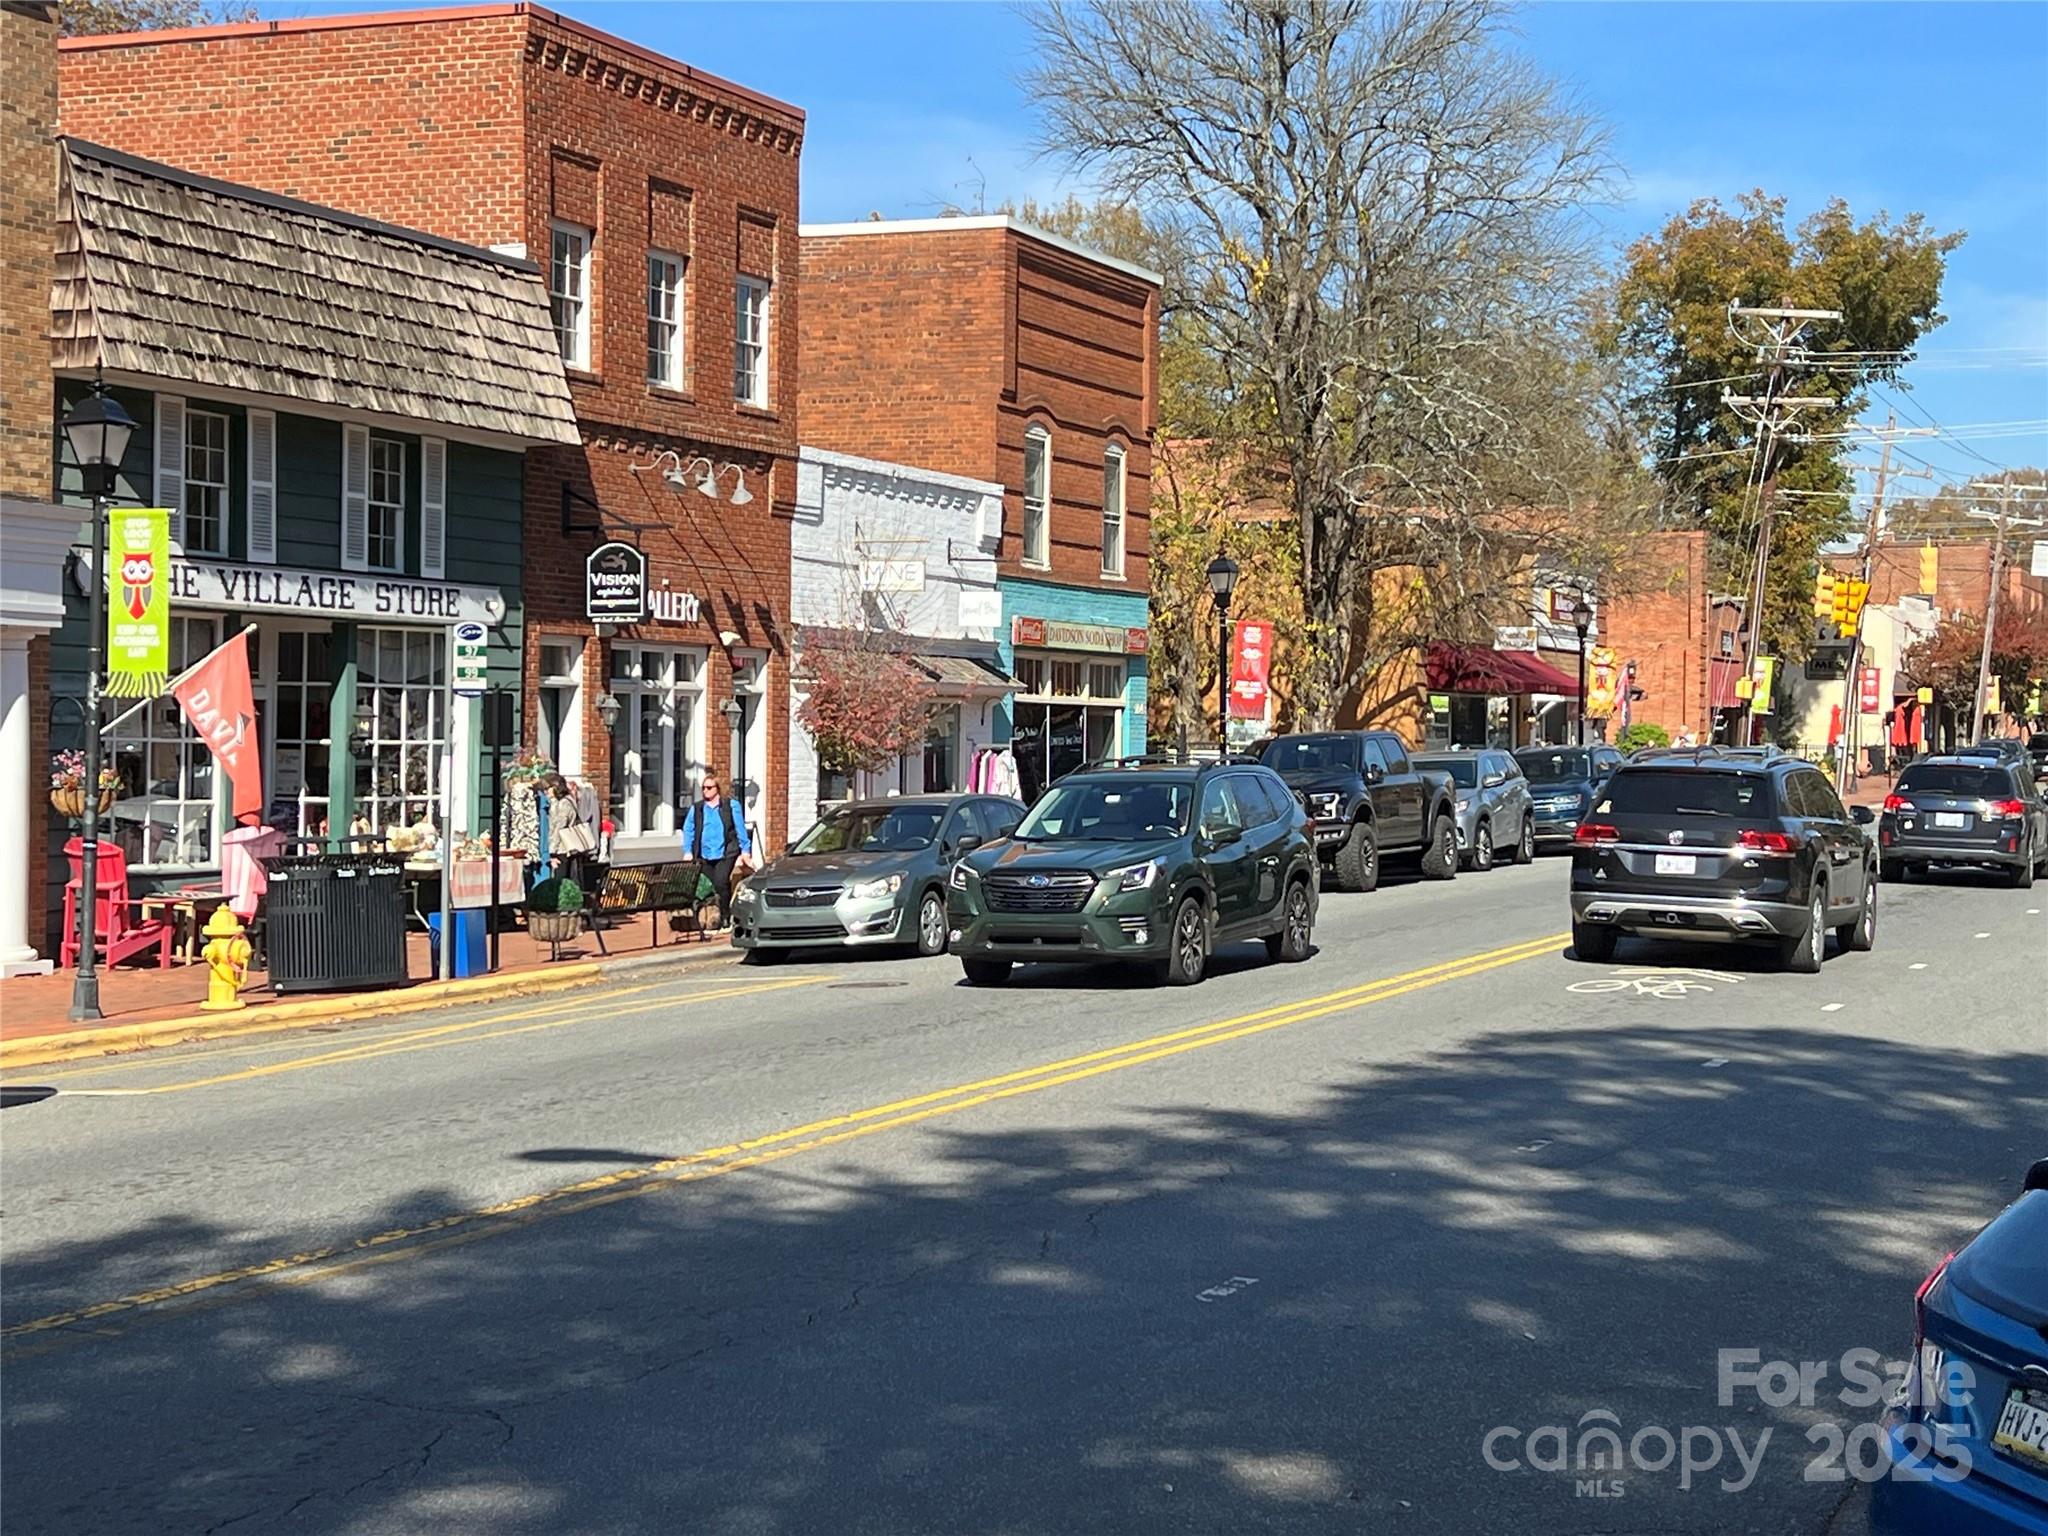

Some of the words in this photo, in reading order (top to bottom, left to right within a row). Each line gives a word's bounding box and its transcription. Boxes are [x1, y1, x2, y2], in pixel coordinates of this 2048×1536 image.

[590, 573, 640, 586] VISION
[169, 565, 200, 598] HE
[217, 568, 356, 609] VILLAGE
[375, 583, 460, 617] STORE
[647, 589, 700, 622] ALLERY
[1049, 627, 1084, 643] DAVIDSON
[1085, 630, 1104, 646] SODA
[1105, 632, 1122, 648] SHOP
[465, 646, 479, 656] 97
[464, 667, 479, 678] 99
